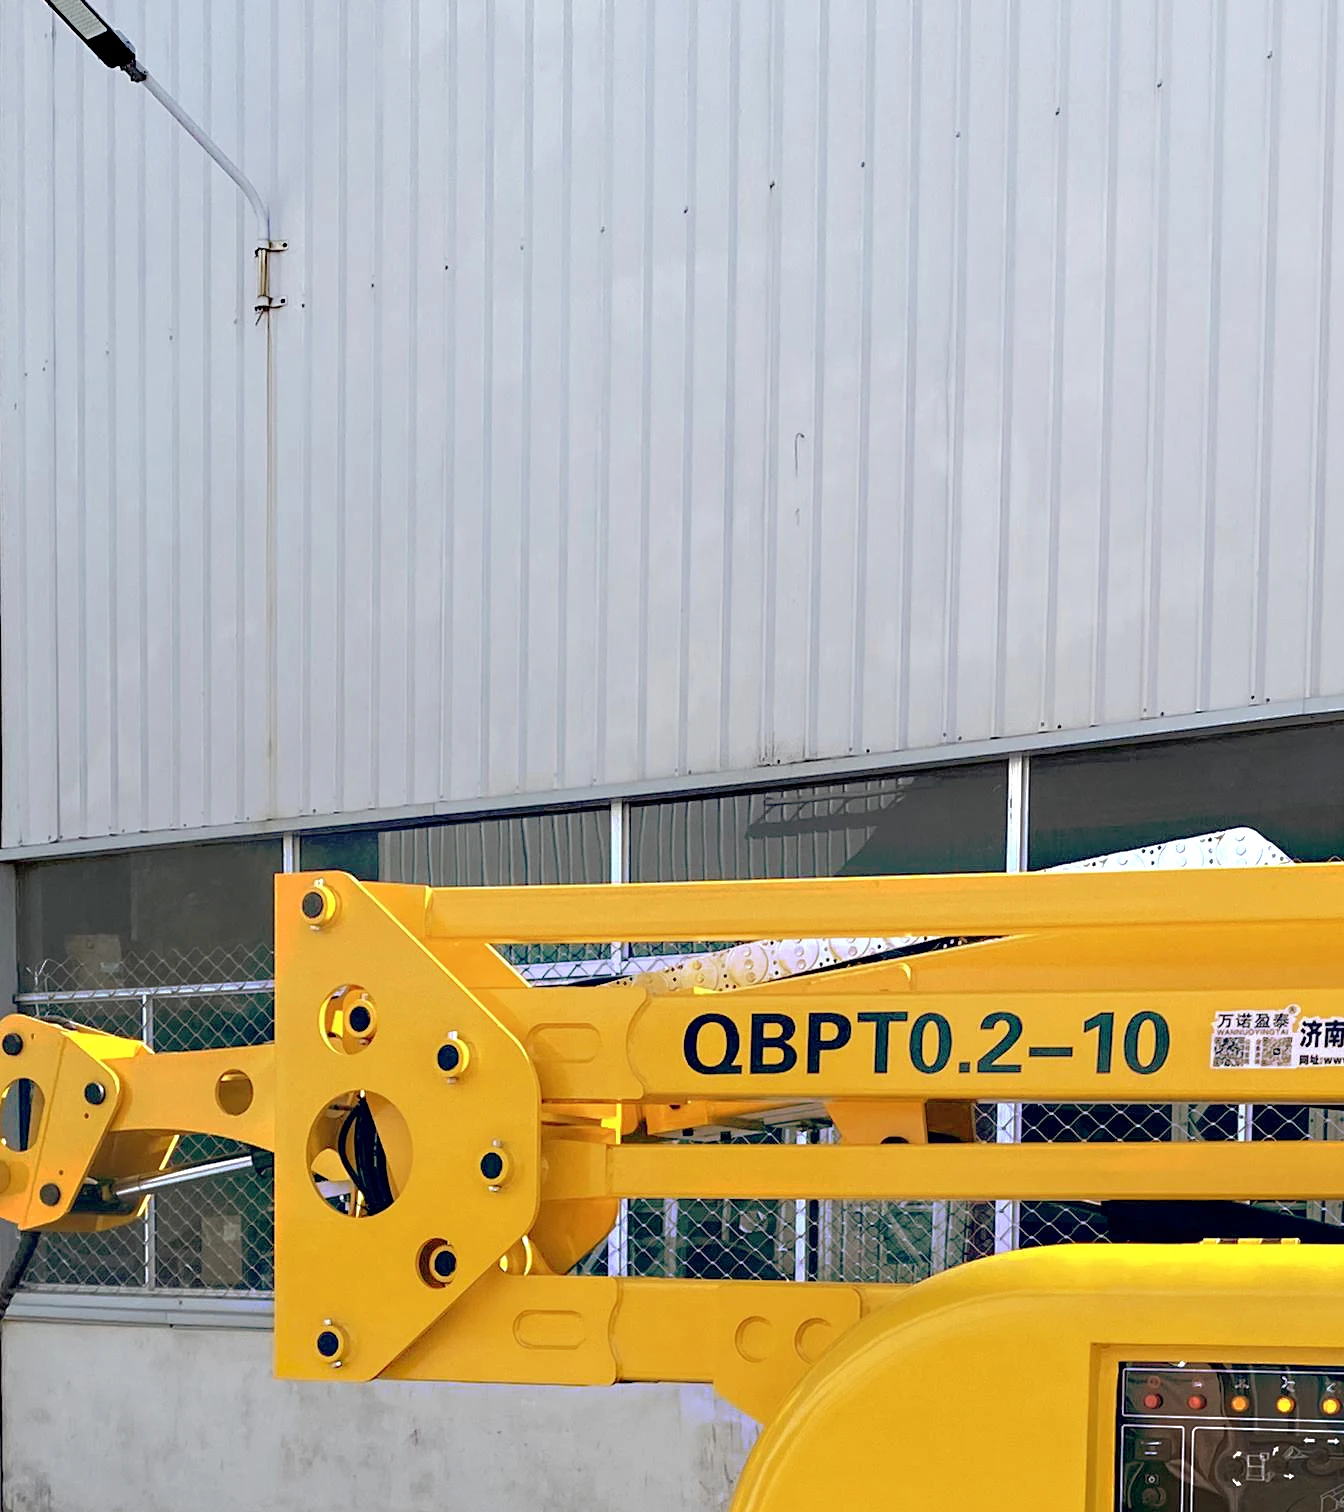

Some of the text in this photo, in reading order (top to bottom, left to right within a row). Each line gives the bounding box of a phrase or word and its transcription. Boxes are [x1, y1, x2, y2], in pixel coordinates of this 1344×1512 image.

[1216, 1013, 1289, 1029] 万诺盈泰
[682, 1010, 1172, 1076] QBPT0.2-10
